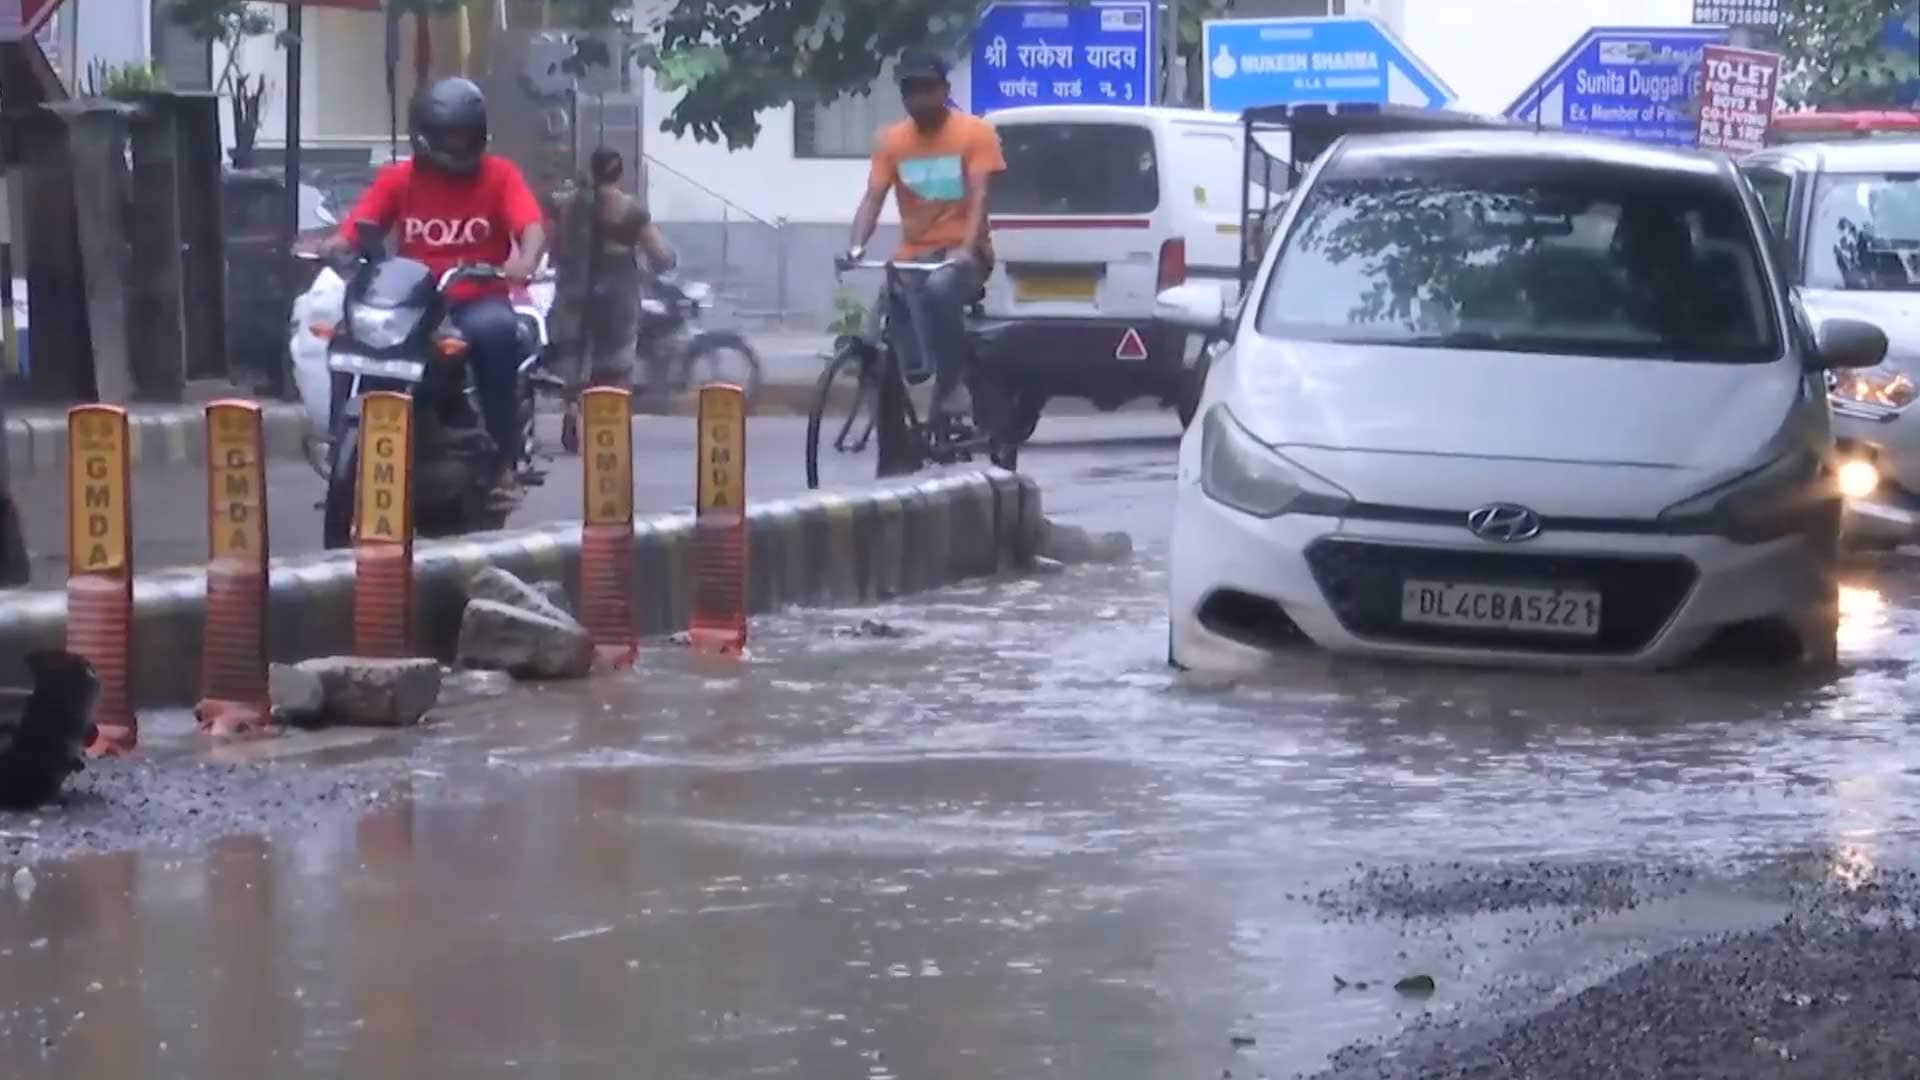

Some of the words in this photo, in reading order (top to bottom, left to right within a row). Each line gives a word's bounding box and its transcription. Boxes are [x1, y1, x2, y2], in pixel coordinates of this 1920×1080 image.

[984, 36, 1007, 68] श्री
[1017, 38, 1073, 69] राकेश
[1085, 45, 1136, 70] यादव
[1312, 51, 1379, 71] SHARMA
[1576, 68, 1625, 95] Sunita
[1629, 69, 1683, 102] Duggal
[1706, 59, 1773, 86] TO-LET
[1591, 104, 1638, 120] Member
[1641, 104, 1655, 121] of
[404, 217, 491, 246] POLO
[226, 447, 249, 550] GMDA
[373, 436, 395, 536] GMDA
[85, 456, 110, 567] GMDA
